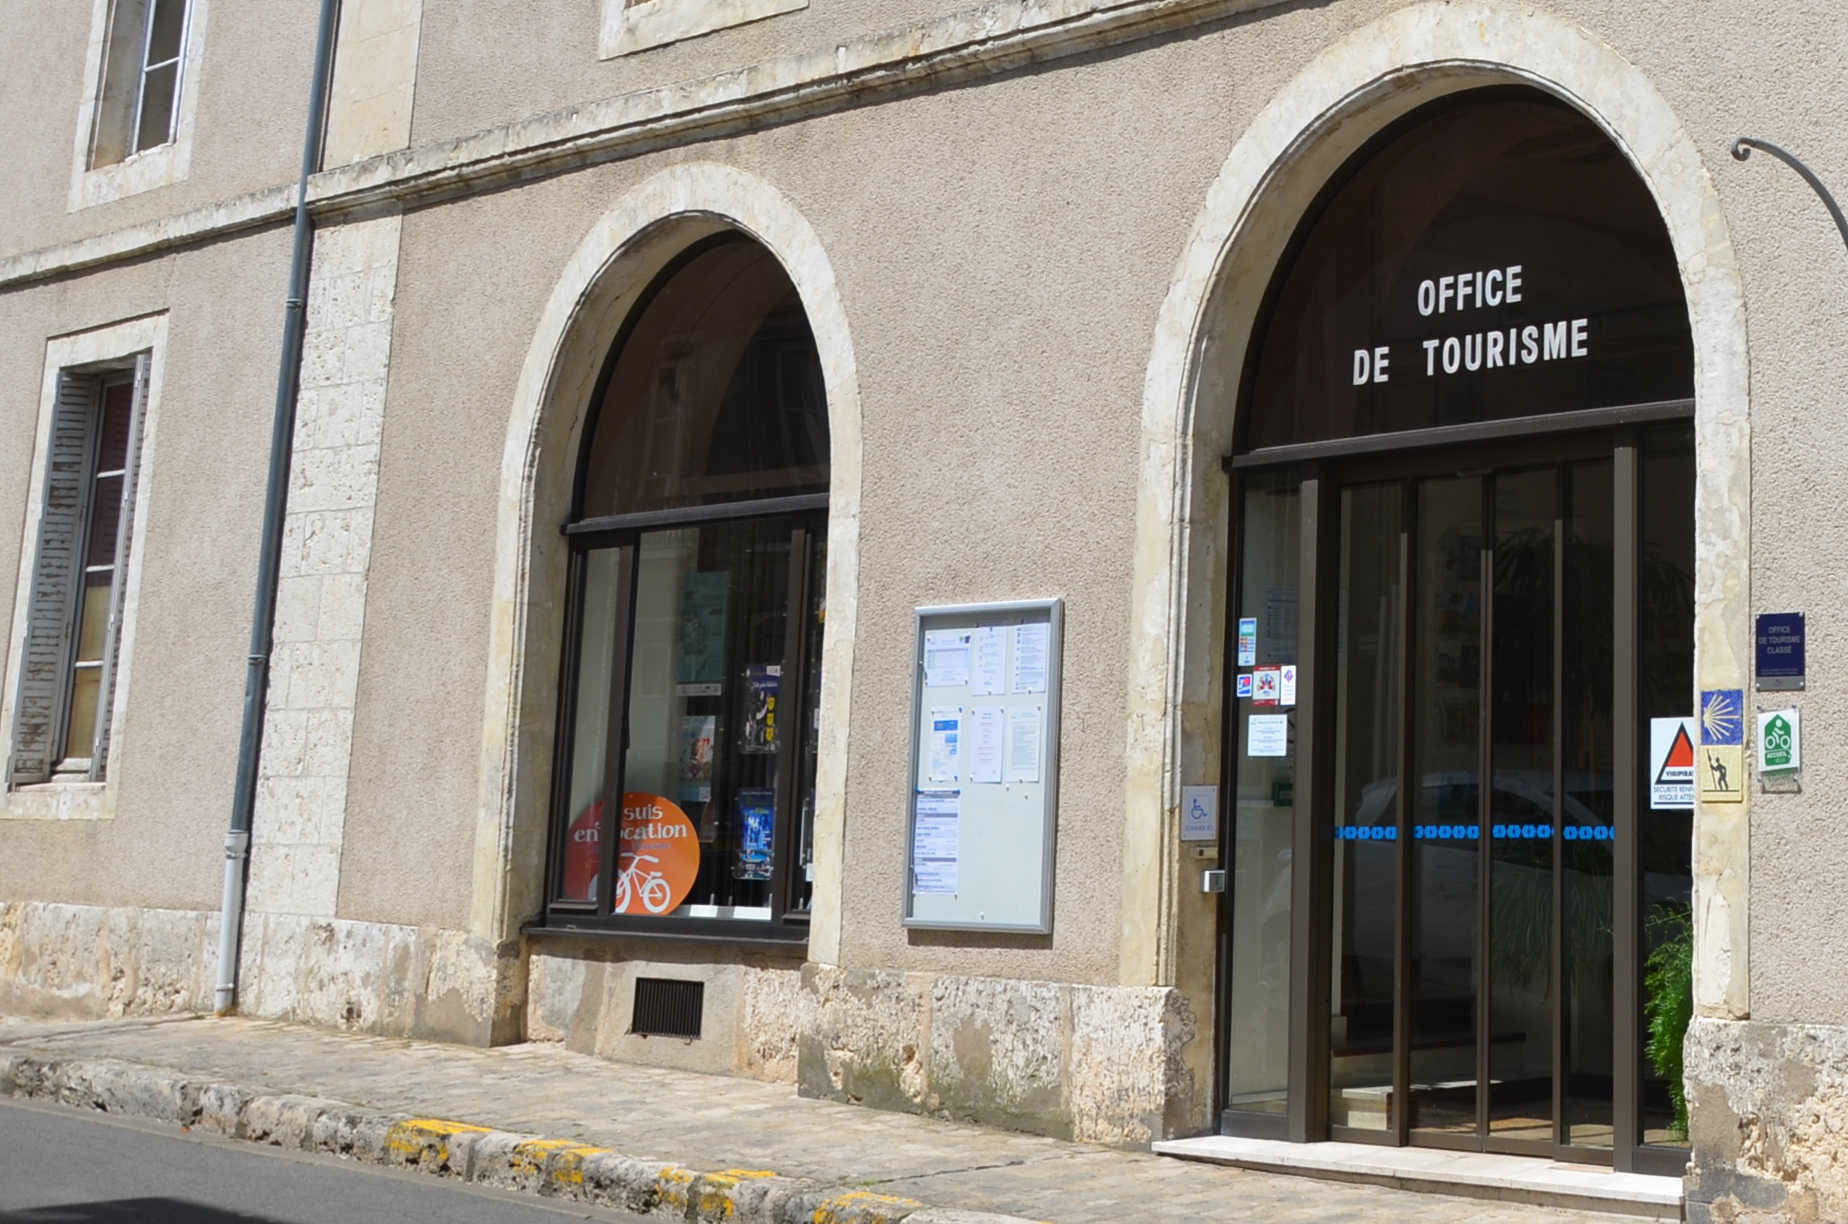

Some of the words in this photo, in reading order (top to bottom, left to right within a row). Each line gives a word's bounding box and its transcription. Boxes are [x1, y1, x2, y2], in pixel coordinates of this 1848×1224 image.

[1417, 265, 1522, 316] OFFICE
[1353, 346, 1390, 385] DE
[1423, 318, 1588, 376] TOURISME
[1768, 626, 1791, 634] OFFICE
[1769, 636, 1800, 644] TOURISME
[624, 803, 663, 821] suis
[574, 828, 599, 843] en
[620, 823, 687, 841] cation
